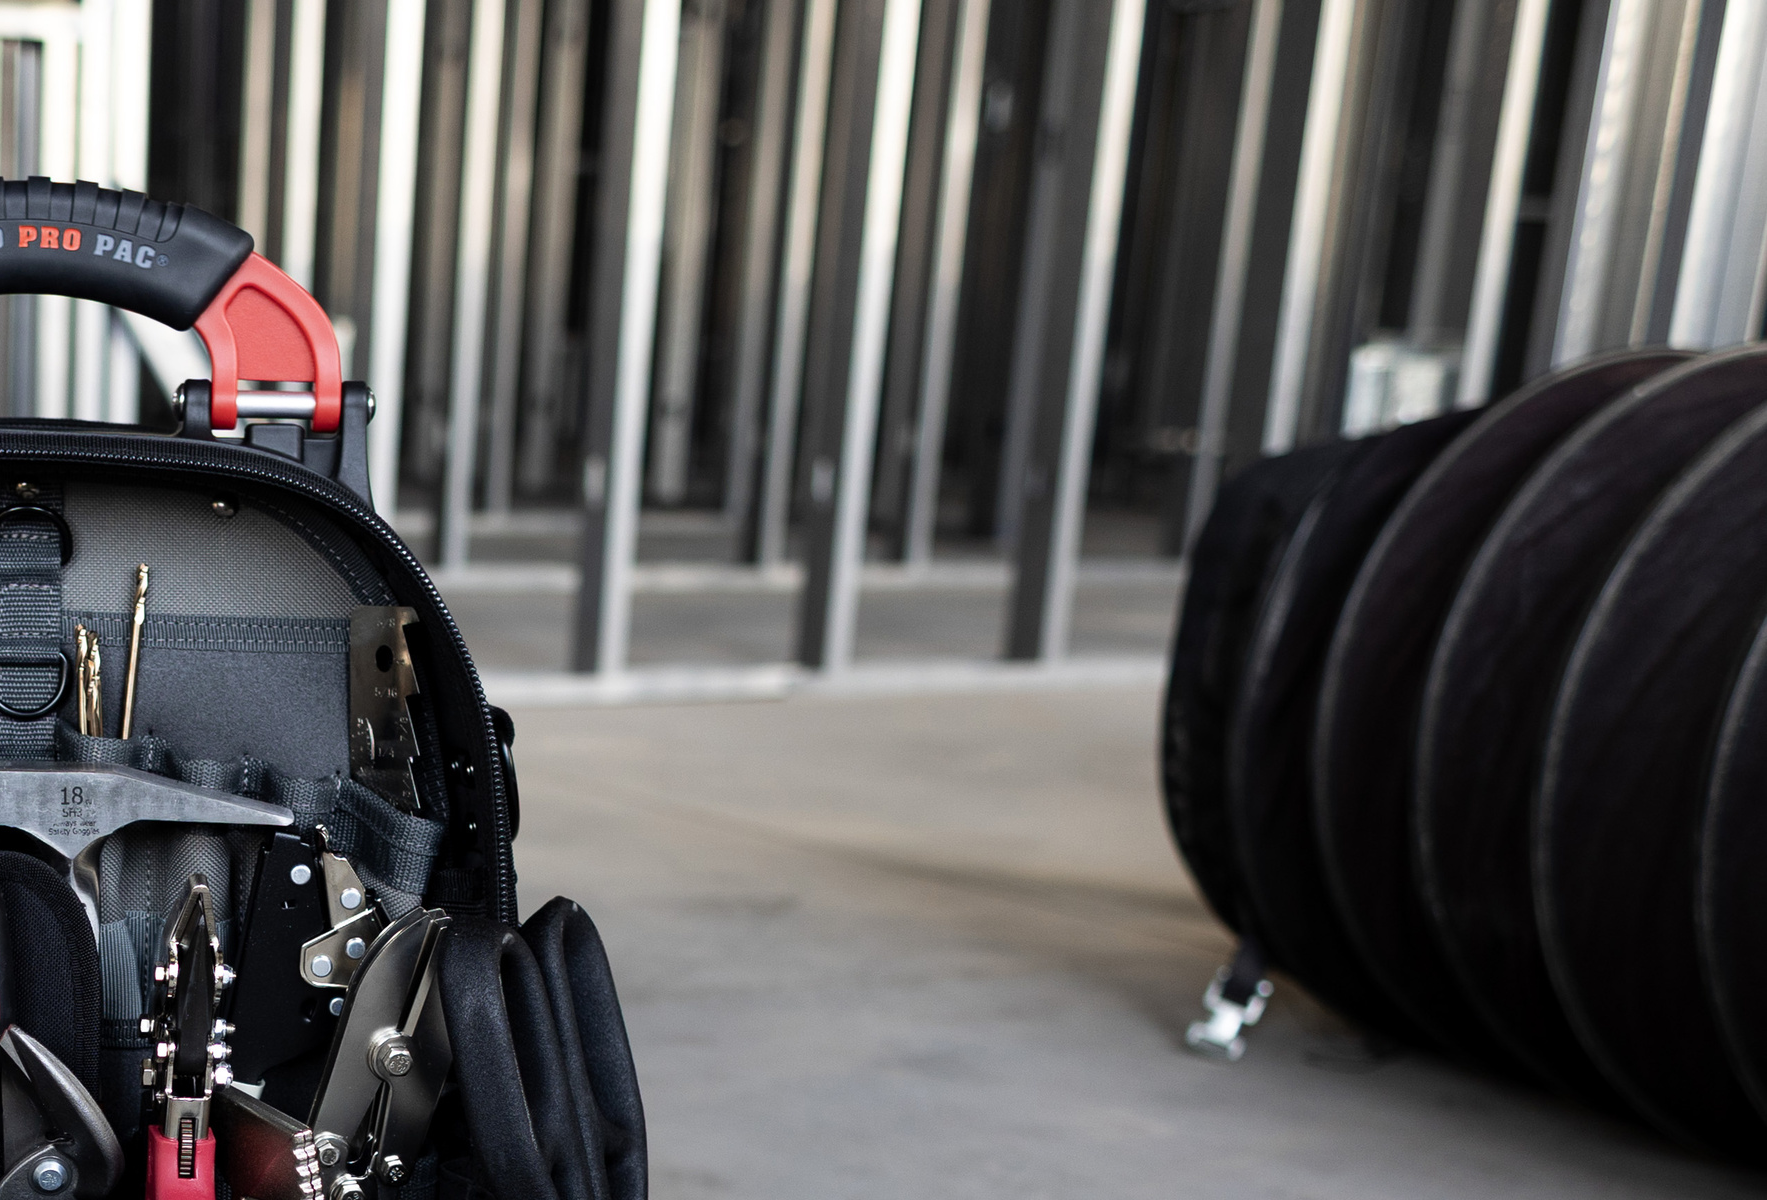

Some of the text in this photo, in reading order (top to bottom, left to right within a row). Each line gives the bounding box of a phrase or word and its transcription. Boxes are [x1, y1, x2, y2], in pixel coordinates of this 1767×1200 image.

[18, 225, 82, 251] PRO
[92, 233, 156, 269] PAC
[375, 687, 398, 698] 5/16
[61, 786, 83, 805] 18
